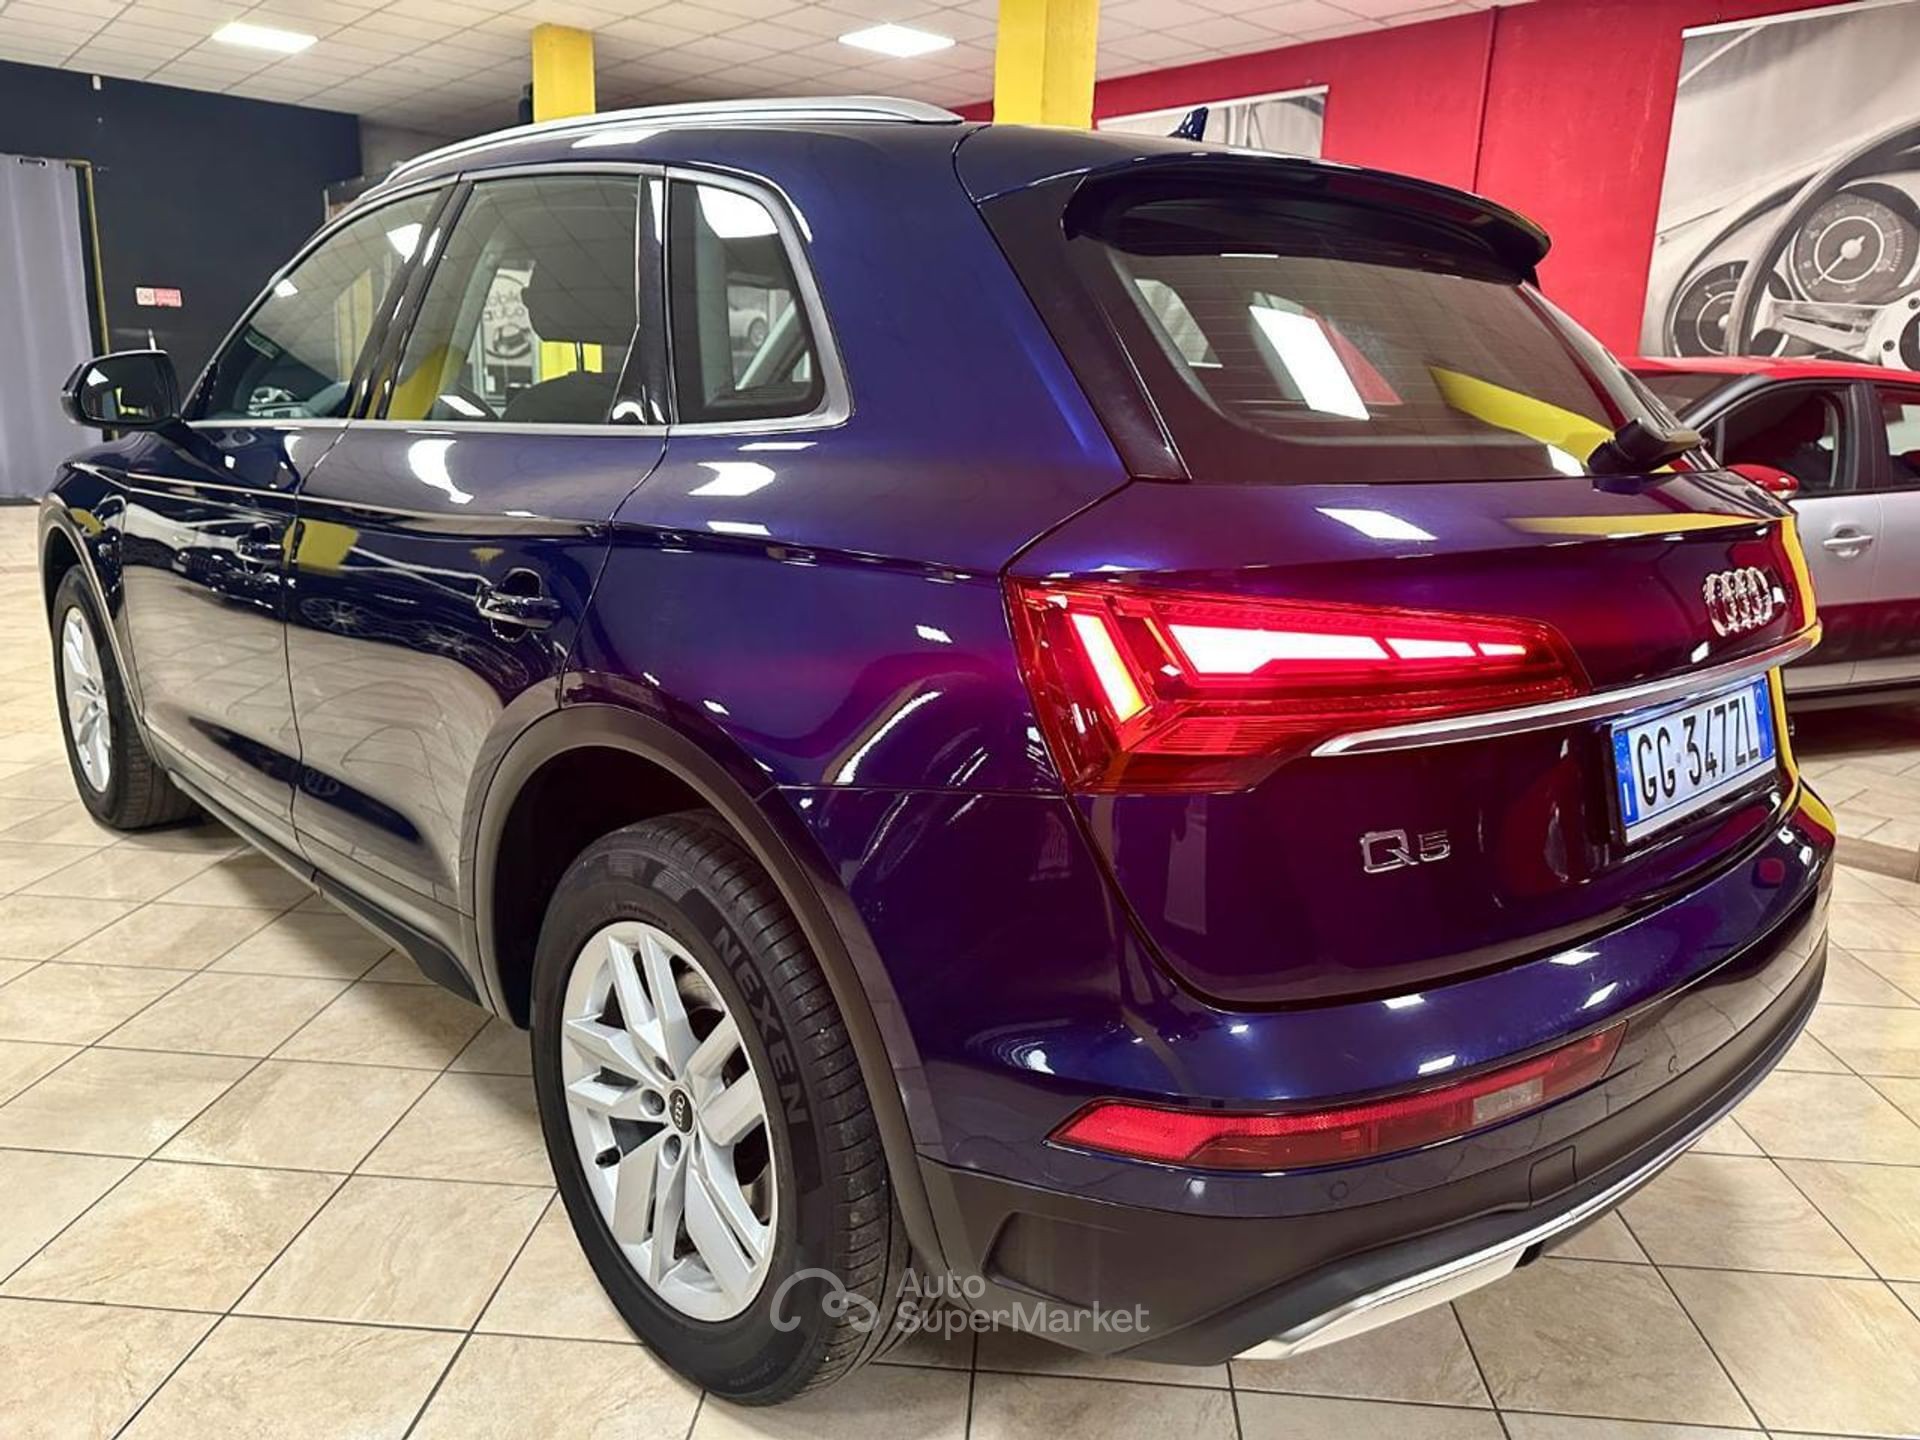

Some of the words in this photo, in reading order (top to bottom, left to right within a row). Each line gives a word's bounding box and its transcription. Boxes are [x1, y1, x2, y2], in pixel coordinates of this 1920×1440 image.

[1636, 727, 1676, 807] GG
[1359, 829, 1450, 873] Q5
[712, 927, 809, 1124] NEXEN
